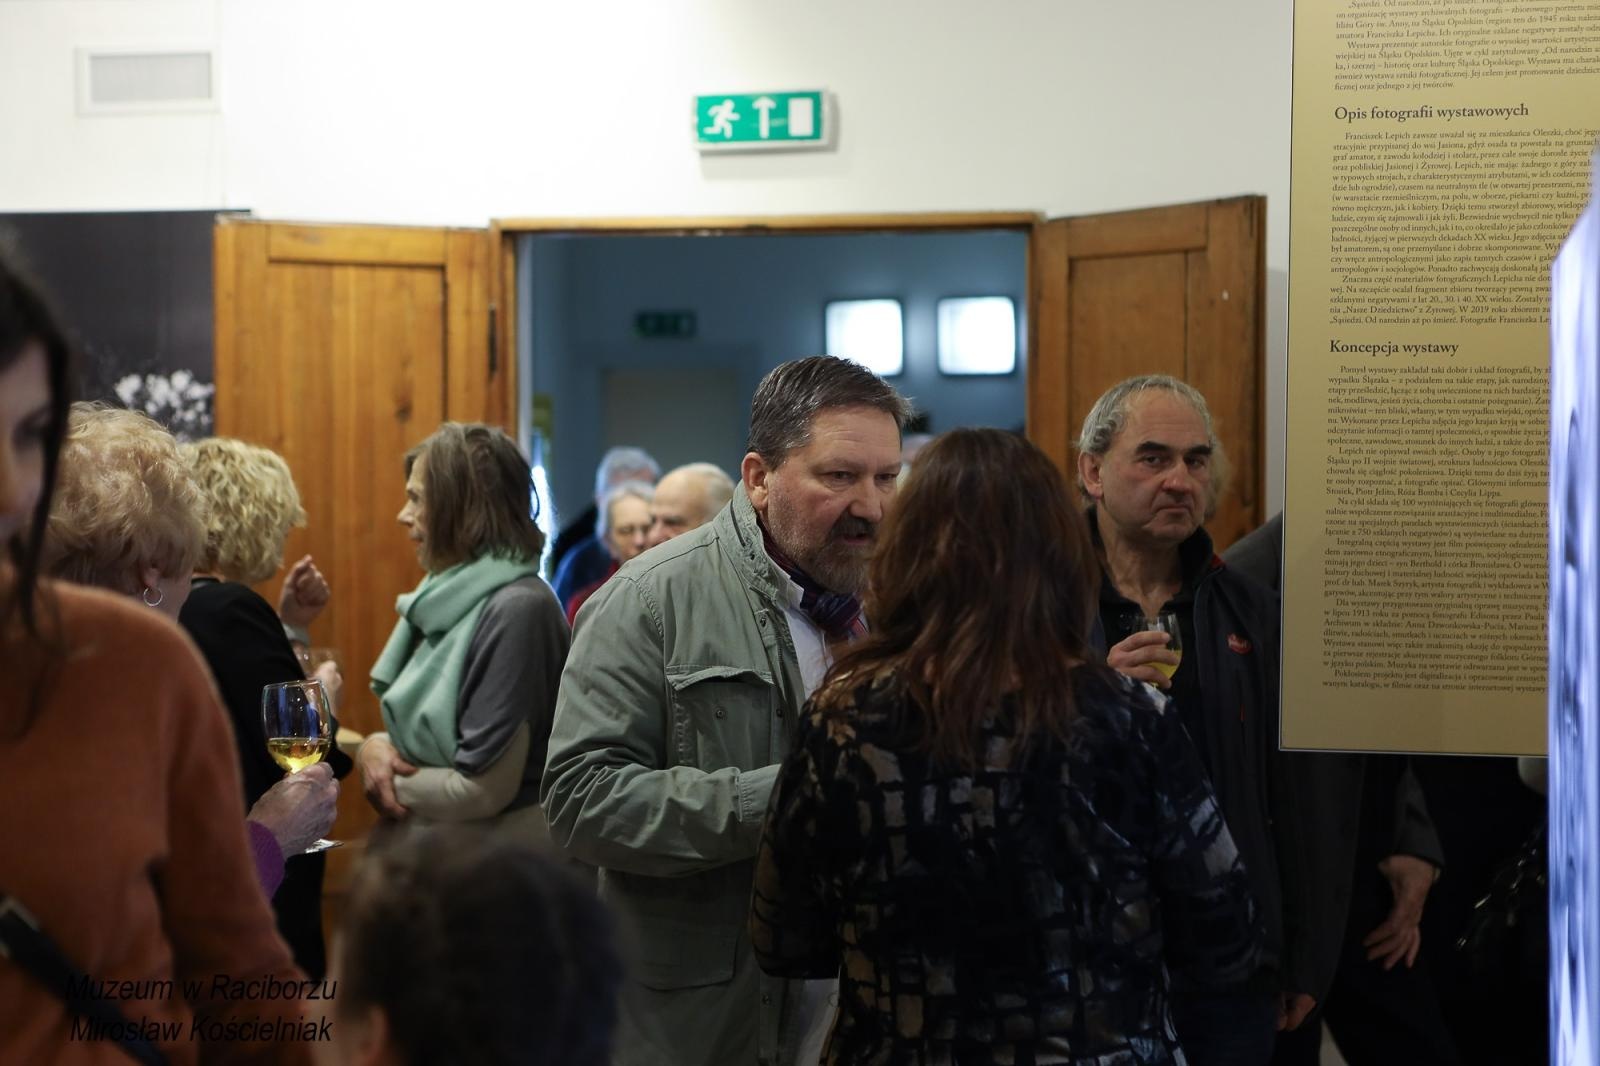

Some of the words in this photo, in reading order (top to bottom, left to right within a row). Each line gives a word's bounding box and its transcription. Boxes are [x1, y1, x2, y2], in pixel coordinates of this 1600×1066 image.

[1412, 81, 1421, 91] jej
[1334, 106, 1367, 123] Opis
[1371, 105, 1432, 122] fotografii
[1437, 103, 1529, 122] wystawowych
[1468, 140, 1486, 151] gdyż
[1560, 159, 1578, 170] góry
[1439, 223, 1450, 234] jak
[1516, 222, 1532, 233] jako
[1330, 340, 1398, 356] Koncepcja
[1403, 342, 1459, 357] wystawy
[1328, 397, 1344, 406] nek,
[1458, 417, 1474, 427] jego
[1494, 448, 1510, 458] jego
